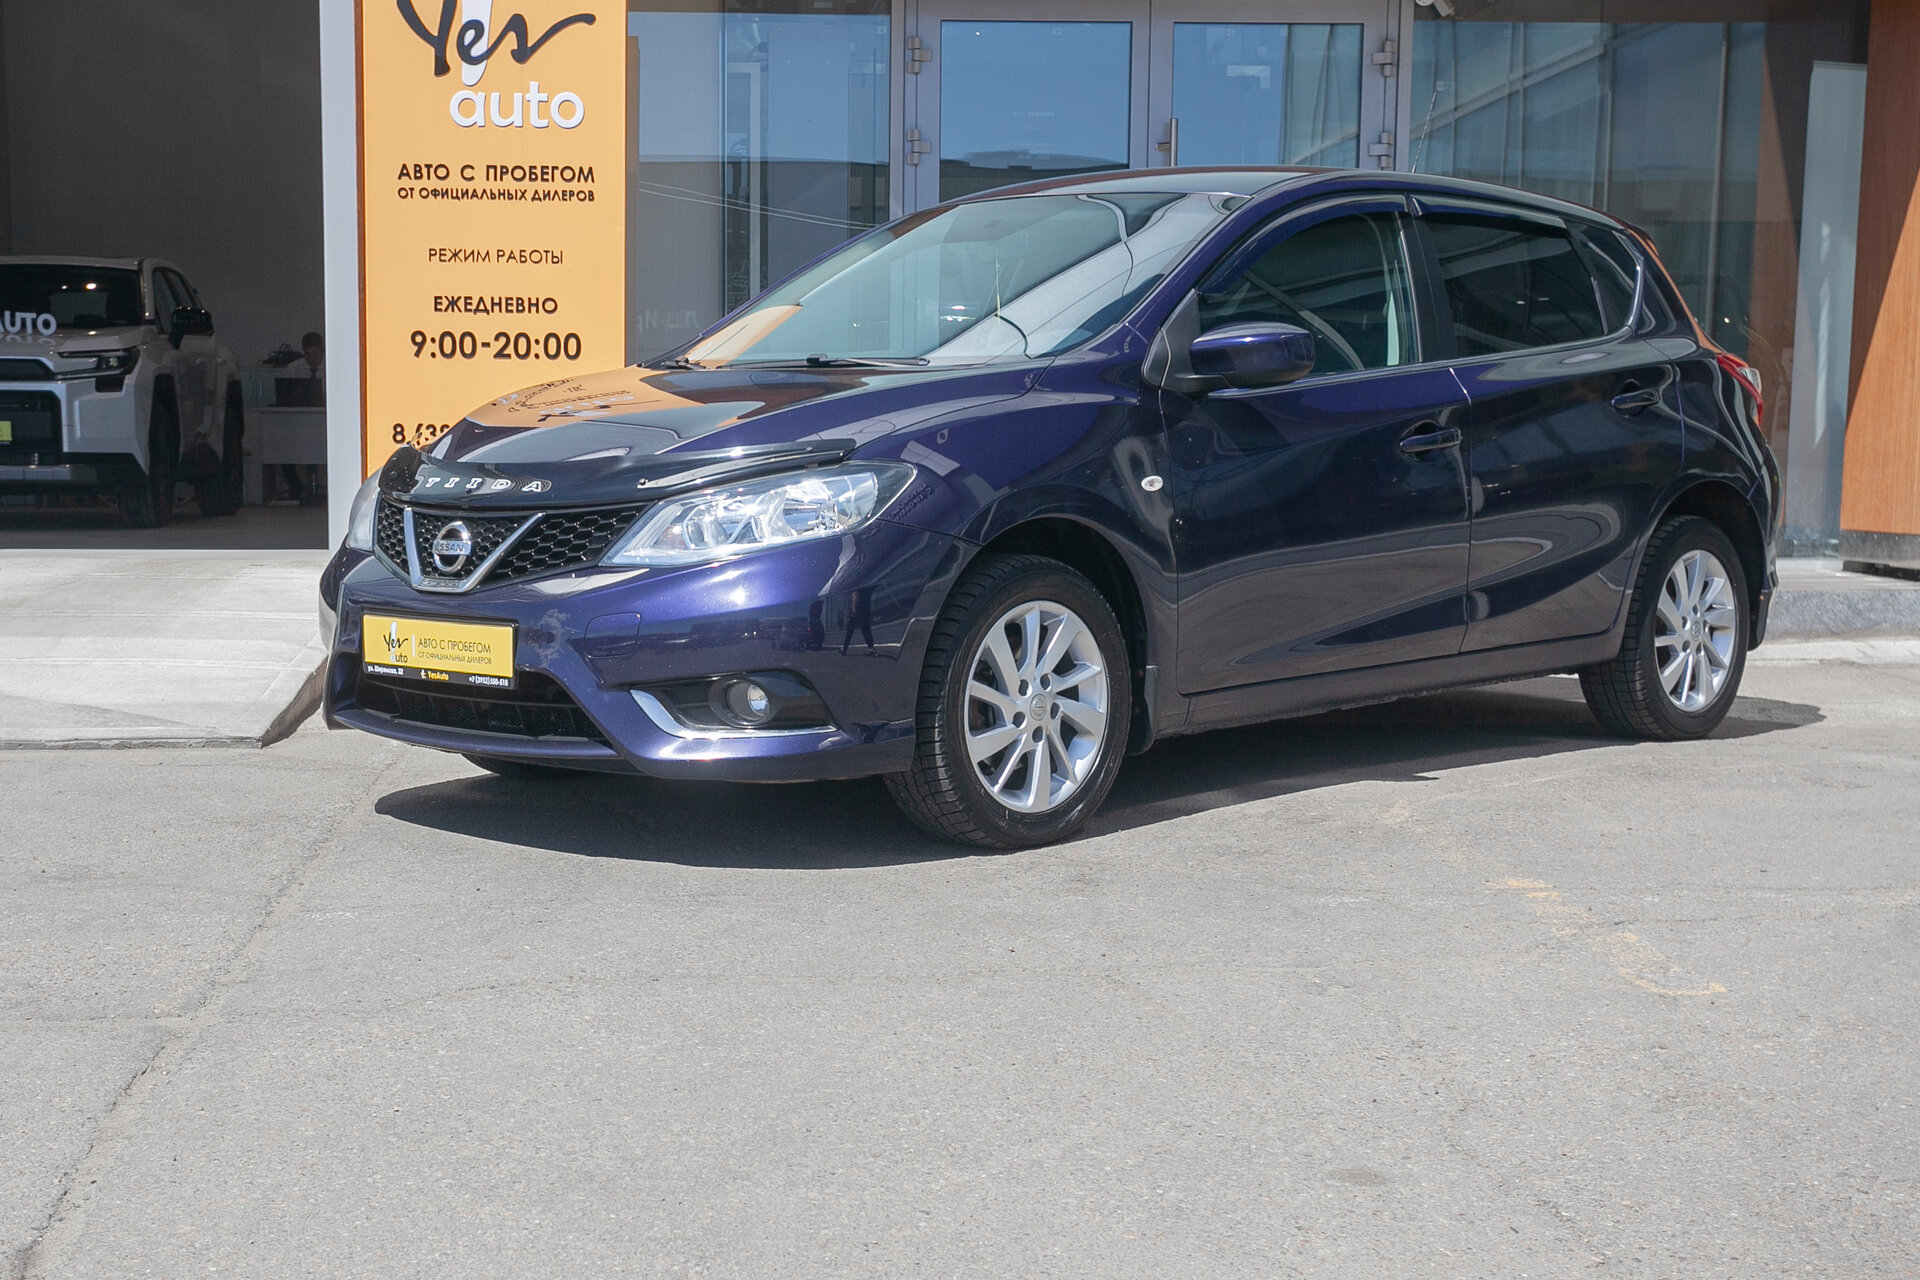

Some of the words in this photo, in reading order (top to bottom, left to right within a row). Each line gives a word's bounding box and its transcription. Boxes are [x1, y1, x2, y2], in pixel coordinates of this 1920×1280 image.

[450, 81, 585, 129] auto
[398, 163, 450, 182] АВТО
[460, 164, 475, 182] С
[485, 164, 595, 183] ПРОБЕГОМ
[397, 187, 415, 200] ОТ
[418, 187, 528, 202] ОФИЦИАЛЬНЫХ
[530, 188, 595, 203] ДИЛЕРОВ
[428, 248, 490, 263] РЕЖИМ
[496, 249, 563, 264] РАБОТЫ
[433, 295, 558, 315] ЕЖЕДНЕВНО
[410, 330, 582, 361] 9:00-20:00
[392, 422, 406, 443] 8
[425, 477, 542, 493] TIIDA
[418, 637, 437, 649] АВТО
[439, 639, 445, 650] С
[448, 640, 492, 654] ПРОБЕГОМ
[426, 651, 466, 663] ОФИЦИАЛЬНЫХ
[466, 656, 492, 665] ДИЛЕРОВ
[427, 671, 449, 681] YesAuto
